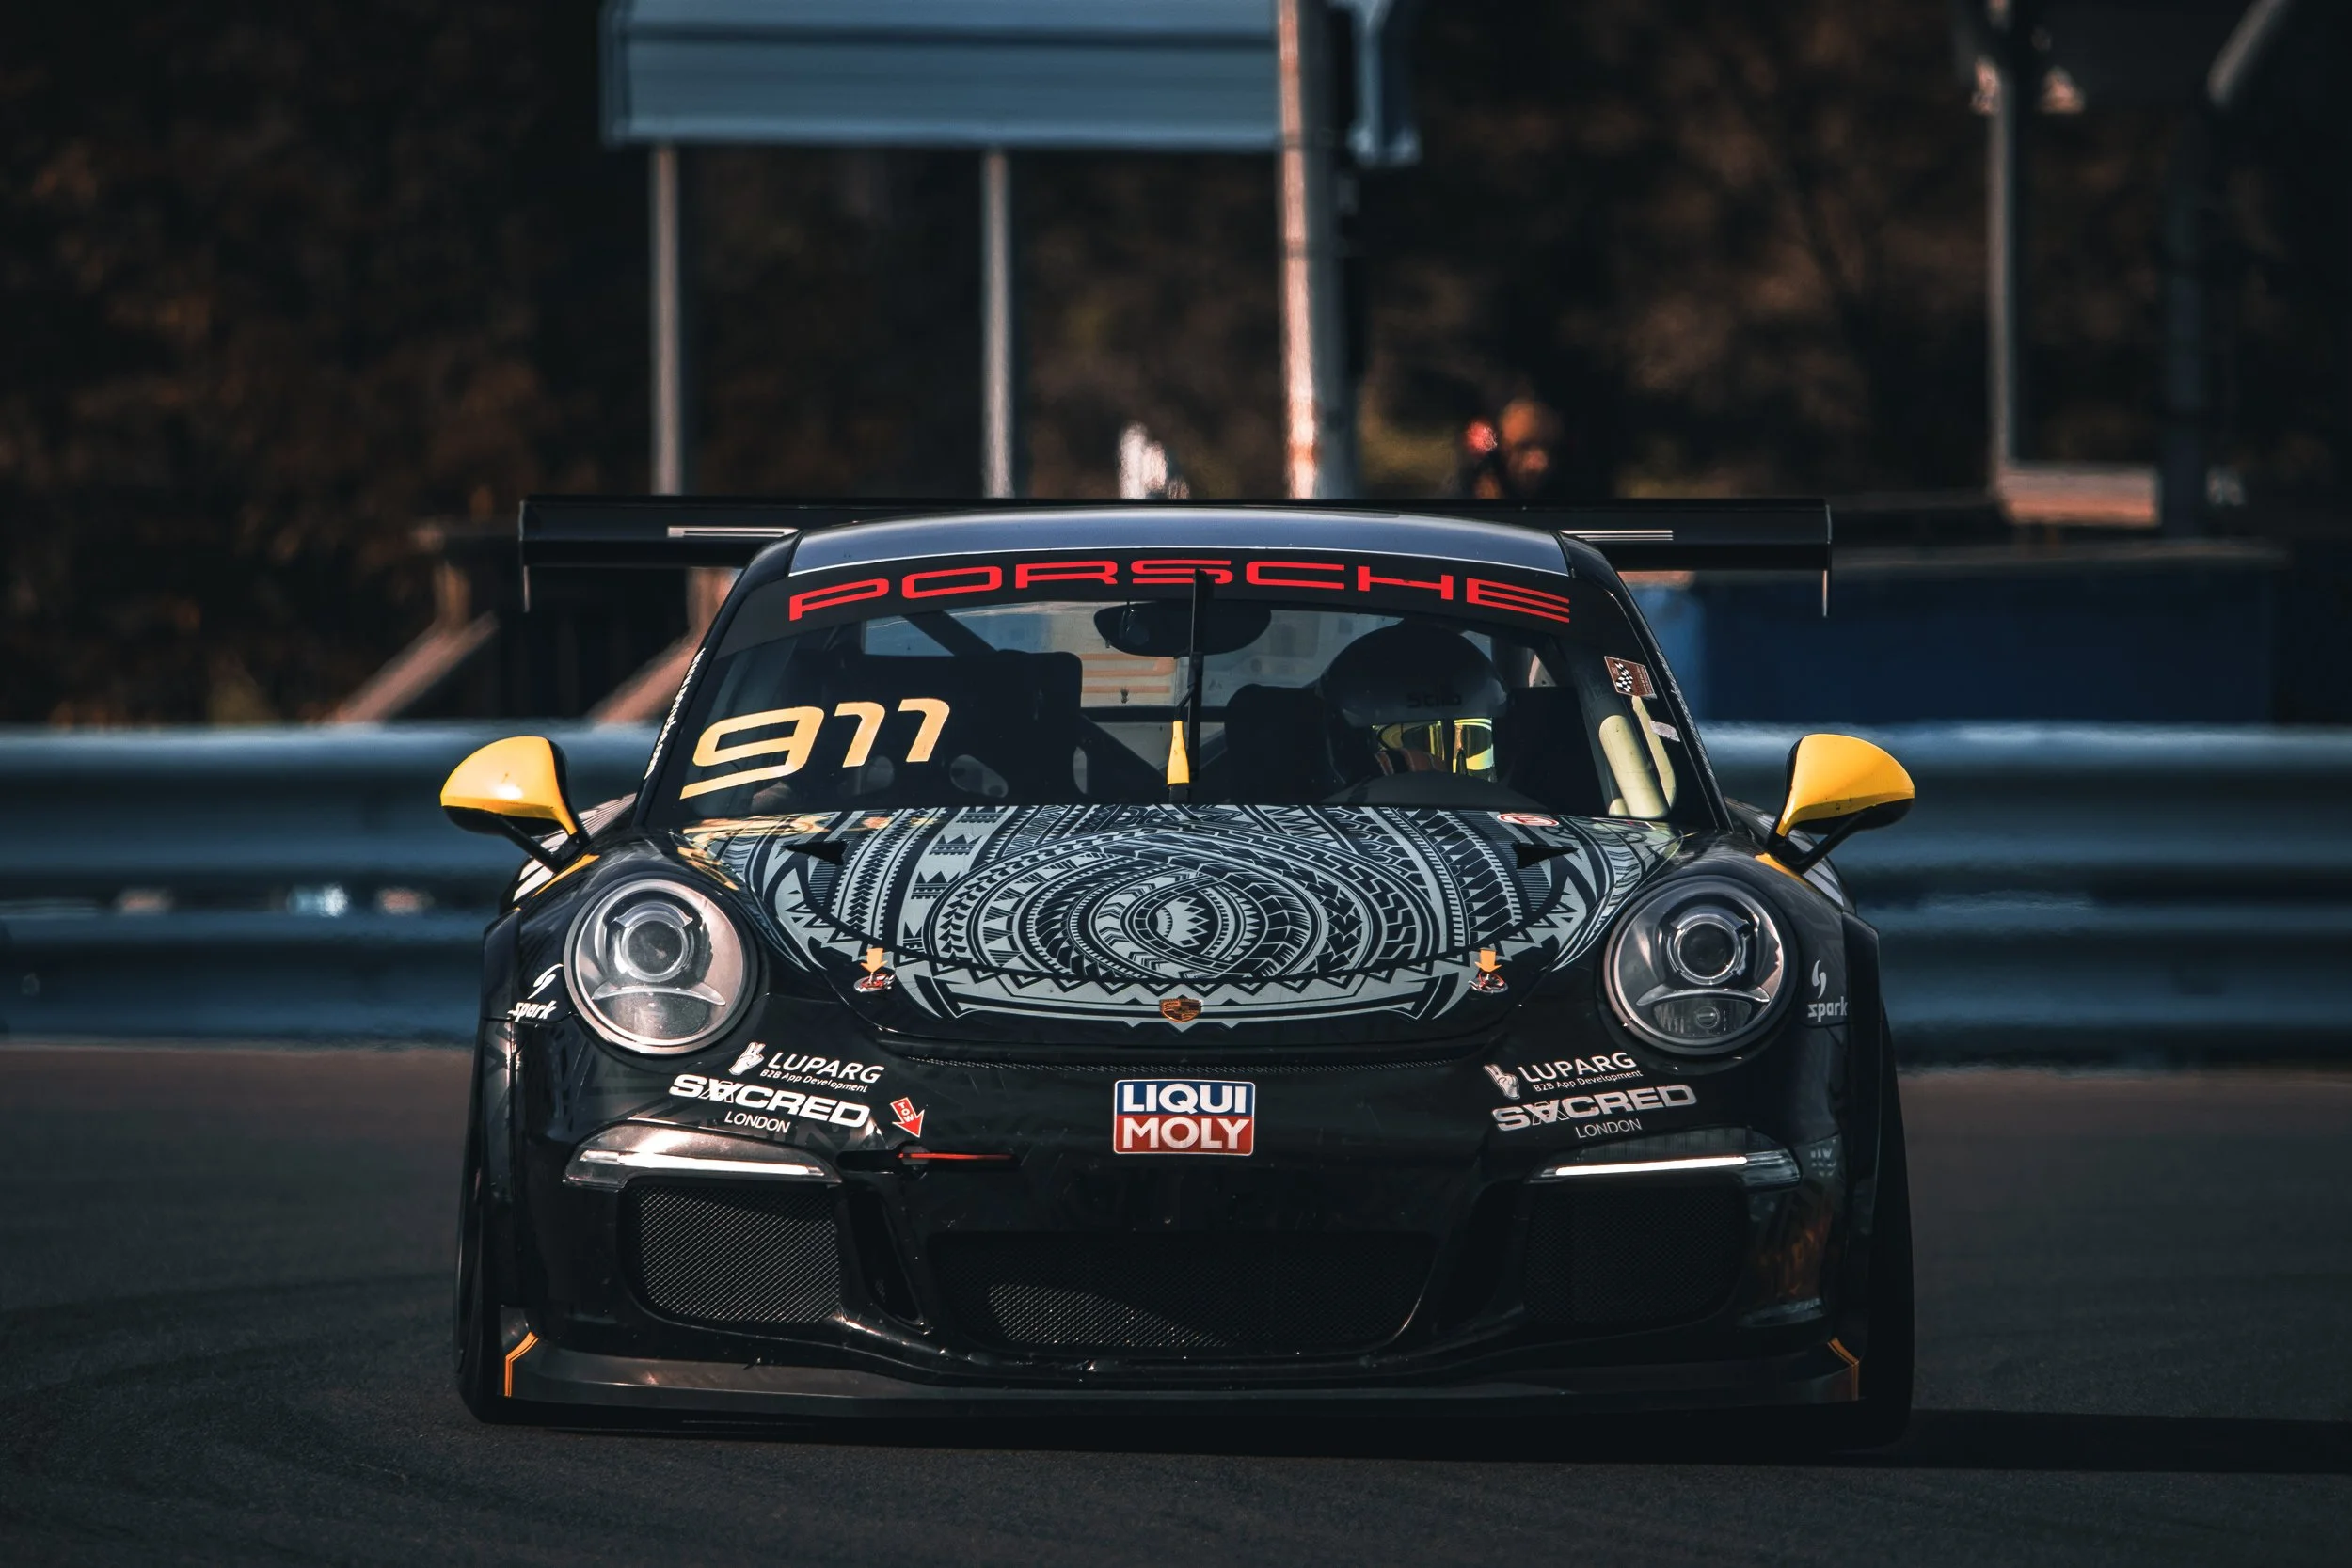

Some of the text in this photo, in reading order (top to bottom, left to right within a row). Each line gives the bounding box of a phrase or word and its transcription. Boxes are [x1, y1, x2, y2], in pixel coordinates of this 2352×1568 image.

[788, 559, 1570, 623] PORSCHE
[679, 698, 950, 800] 911
[507, 1000, 557, 1022] spark
[1807, 996, 1848, 1022] spark
[768, 1053, 885, 1084] LUPARG
[1518, 1052, 1638, 1083] LUPARG
[760, 1069, 867, 1093] B2B App Development
[1533, 1069, 1644, 1093] B2B App Development
[898, 1102, 914, 1122] TOW
[1123, 1084, 1247, 1115] LIQUI
[724, 1111, 791, 1133] LONDON
[1122, 1117, 1249, 1149] MOLY
[1575, 1118, 1643, 1139] LONDON
